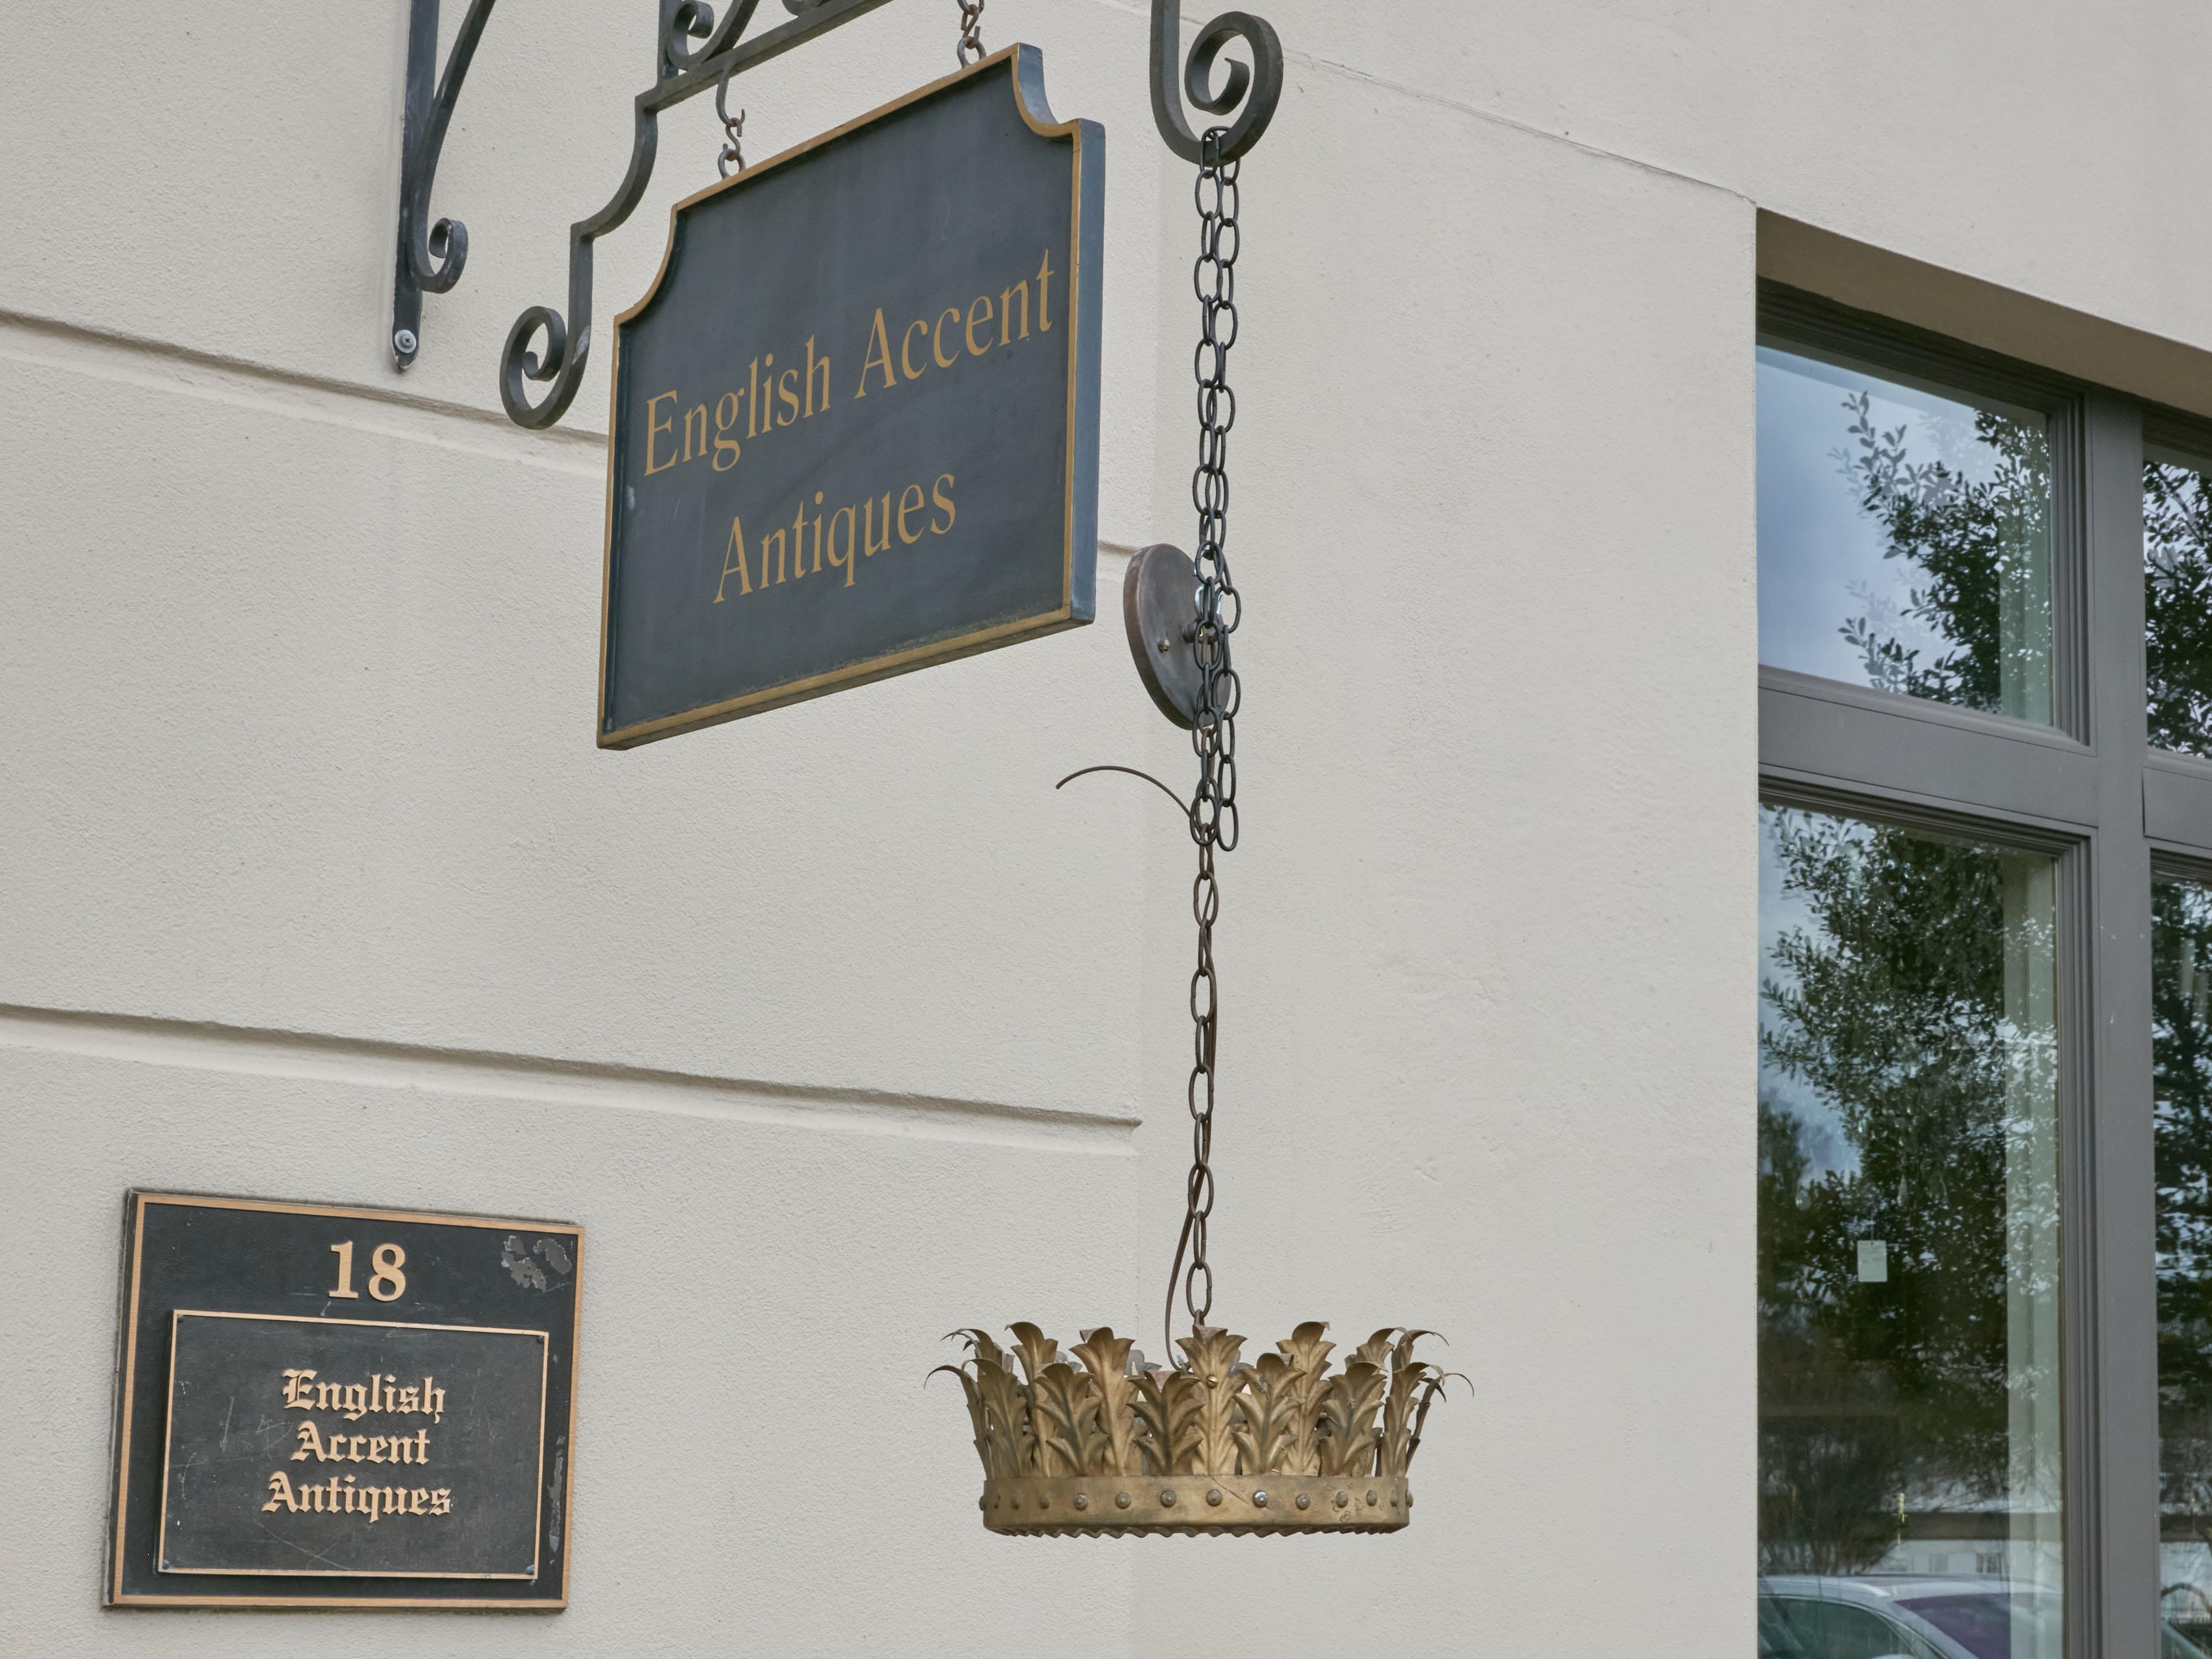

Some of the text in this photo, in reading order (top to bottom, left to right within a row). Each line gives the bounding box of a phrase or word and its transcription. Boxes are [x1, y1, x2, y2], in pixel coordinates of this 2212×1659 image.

[643, 248, 1056, 477] English Accent
[713, 473, 956, 604] Antiques
[328, 1241, 407, 1302] 18
[282, 1368, 446, 1423] English
[290, 1421, 430, 1465] Accent
[262, 1471, 452, 1523] Antiques
